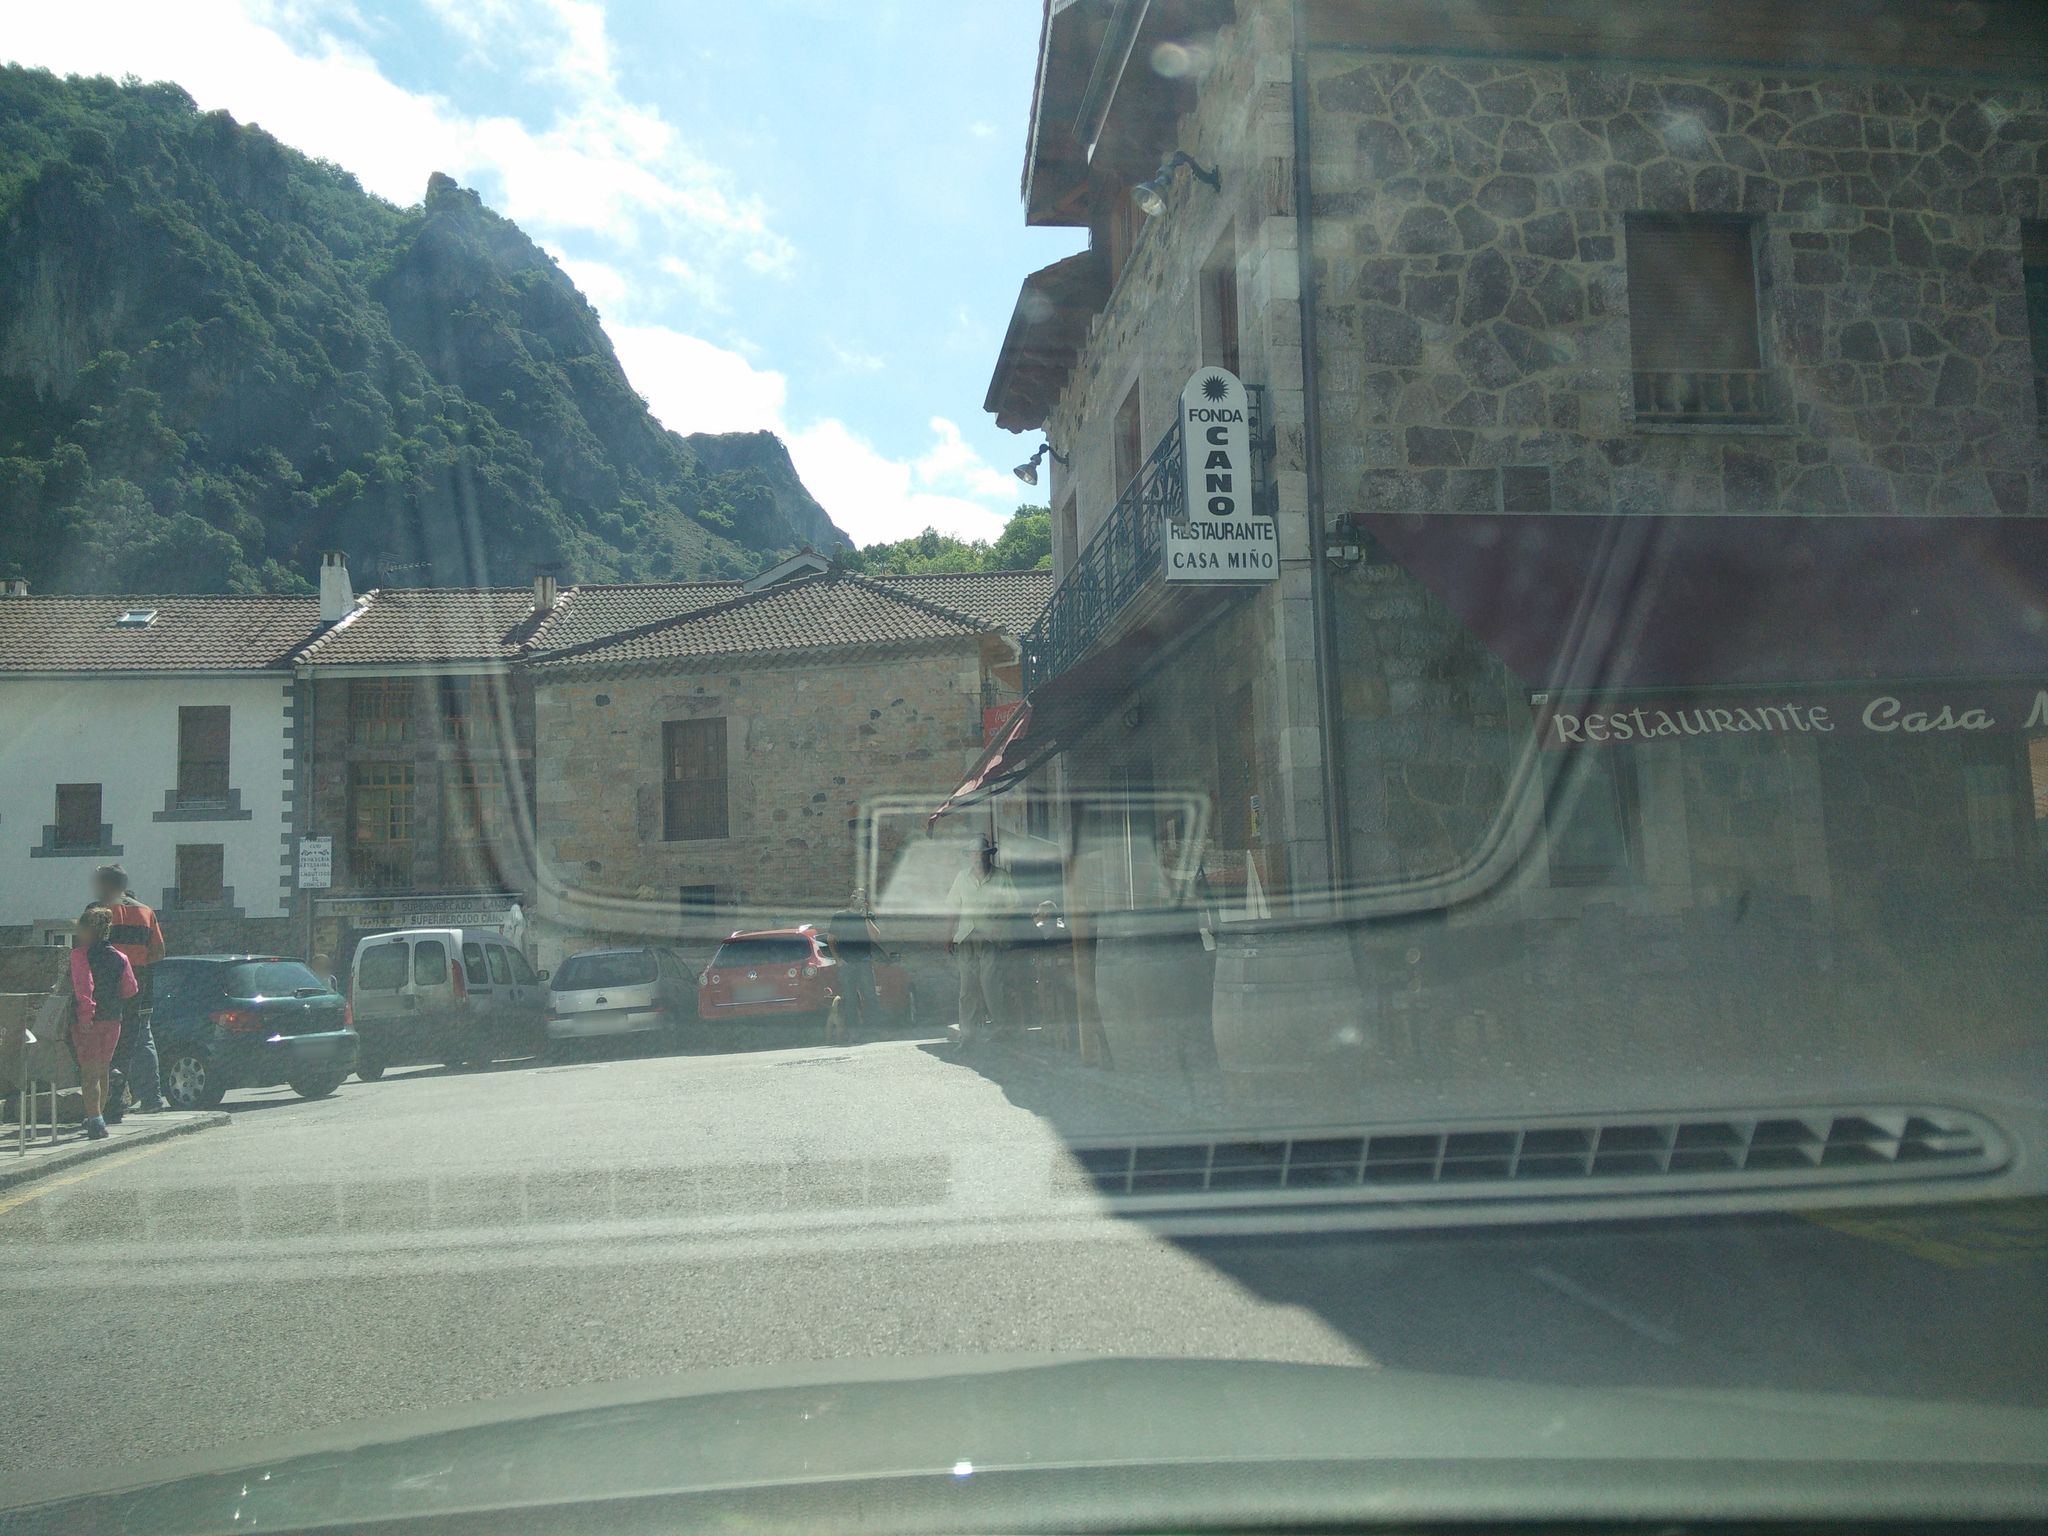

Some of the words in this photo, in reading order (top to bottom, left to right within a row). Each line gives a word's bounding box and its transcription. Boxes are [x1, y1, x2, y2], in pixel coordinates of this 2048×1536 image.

[1189, 408, 1243, 423] FONDA
[1204, 426, 1235, 516] CANO
[1171, 522, 1273, 540] RESTAURANTE
[1173, 552, 1220, 569] CASA
[1228, 549, 1273, 569] MIÑO
[1862, 695, 1996, 732] Casa
[402, 901, 473, 912] SUPERMERCADO
[411, 914, 480, 925] SUPERMERCADO
